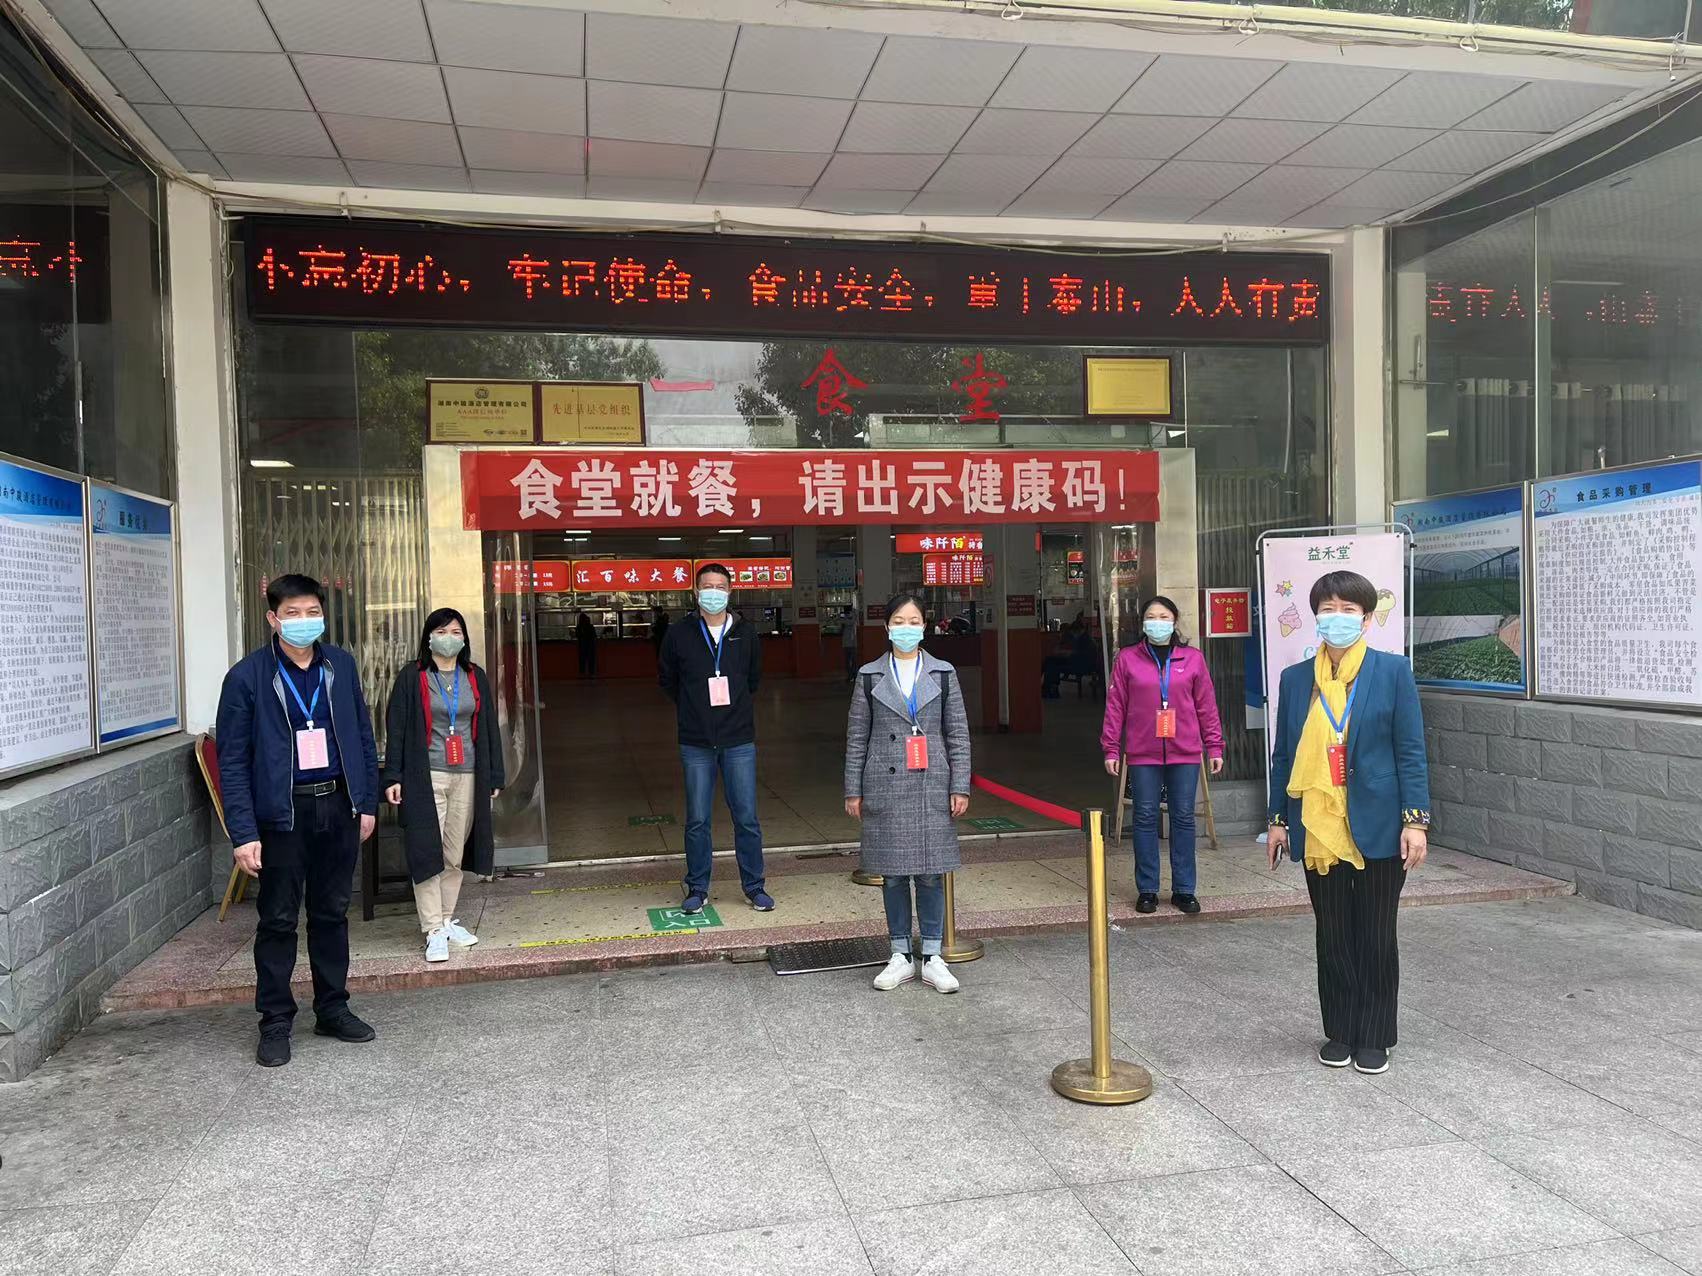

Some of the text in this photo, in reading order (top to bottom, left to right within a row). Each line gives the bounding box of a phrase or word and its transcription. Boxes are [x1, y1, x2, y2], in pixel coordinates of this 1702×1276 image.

[800, 347, 1008, 424] 食堂
[553, 402, 632, 416] 先进基层党组织
[509, 457, 1127, 520] 食堂就餐，请出示健康码！
[1576, 482, 1652, 503] 食品采购管理
[1307, 545, 1350, 562] 益禾堂
[576, 566, 688, 584] 汇百味大餐
